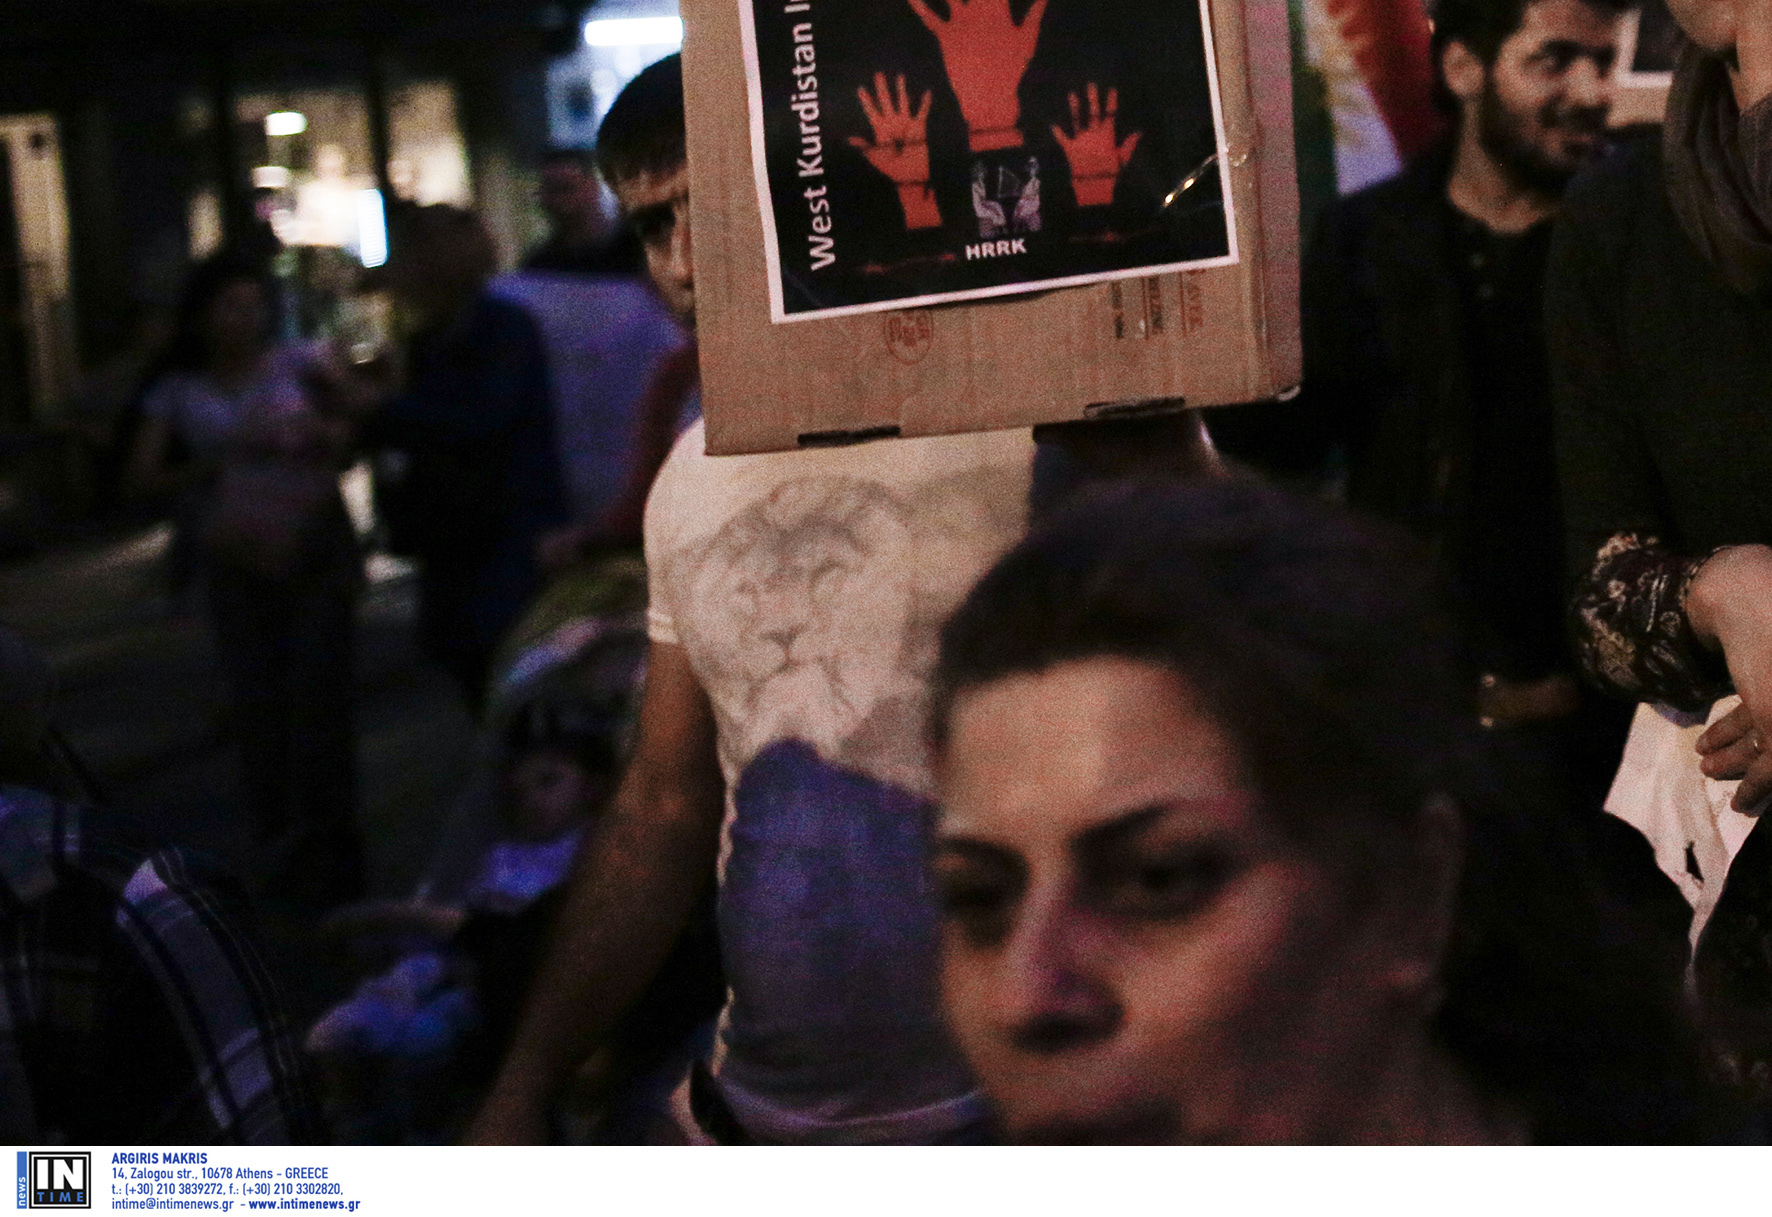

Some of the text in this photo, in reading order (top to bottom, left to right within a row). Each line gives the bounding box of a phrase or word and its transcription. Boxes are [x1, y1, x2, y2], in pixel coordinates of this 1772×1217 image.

[790, 23, 824, 178] Kurdistan
[804, 185, 836, 271] West
[965, 238, 1027, 261] HRRK
